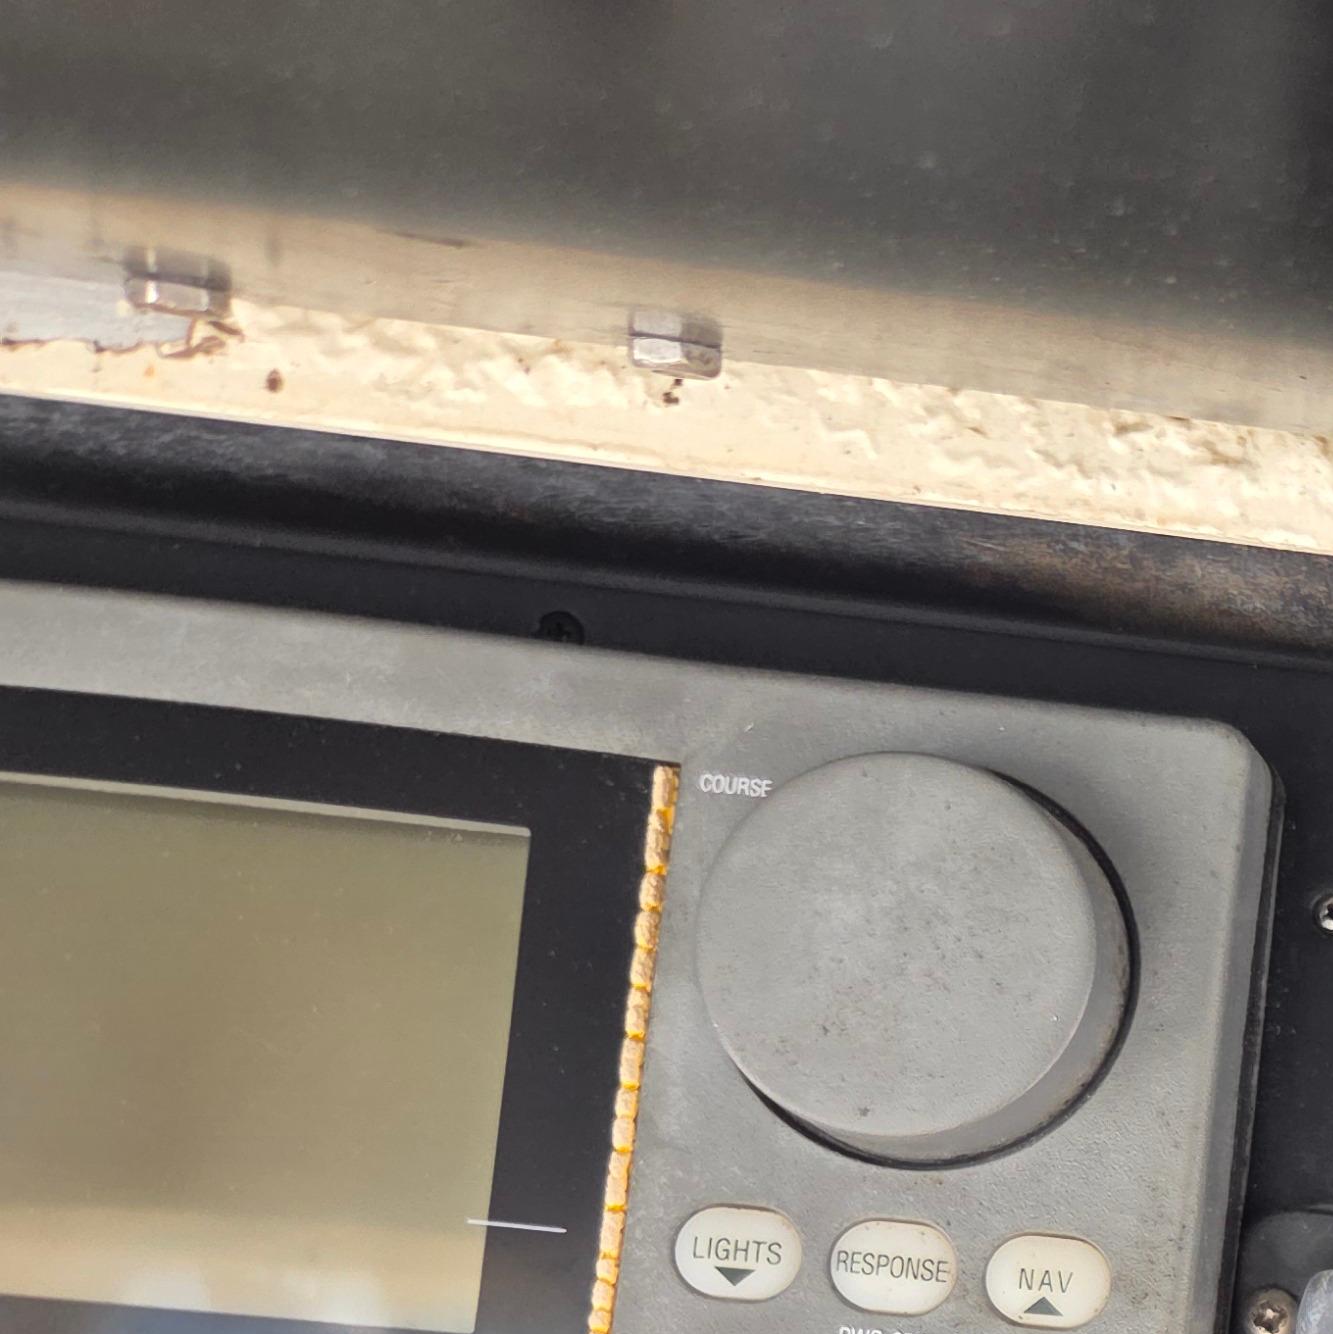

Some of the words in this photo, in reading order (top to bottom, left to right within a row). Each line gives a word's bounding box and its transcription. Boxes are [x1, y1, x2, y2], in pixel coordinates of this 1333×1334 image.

[700, 774, 773, 798] COURSE
[692, 1235, 783, 1266] LIGHTS
[836, 1251, 949, 1283] RESPONSE
[1018, 1268, 1074, 1294] NAV
